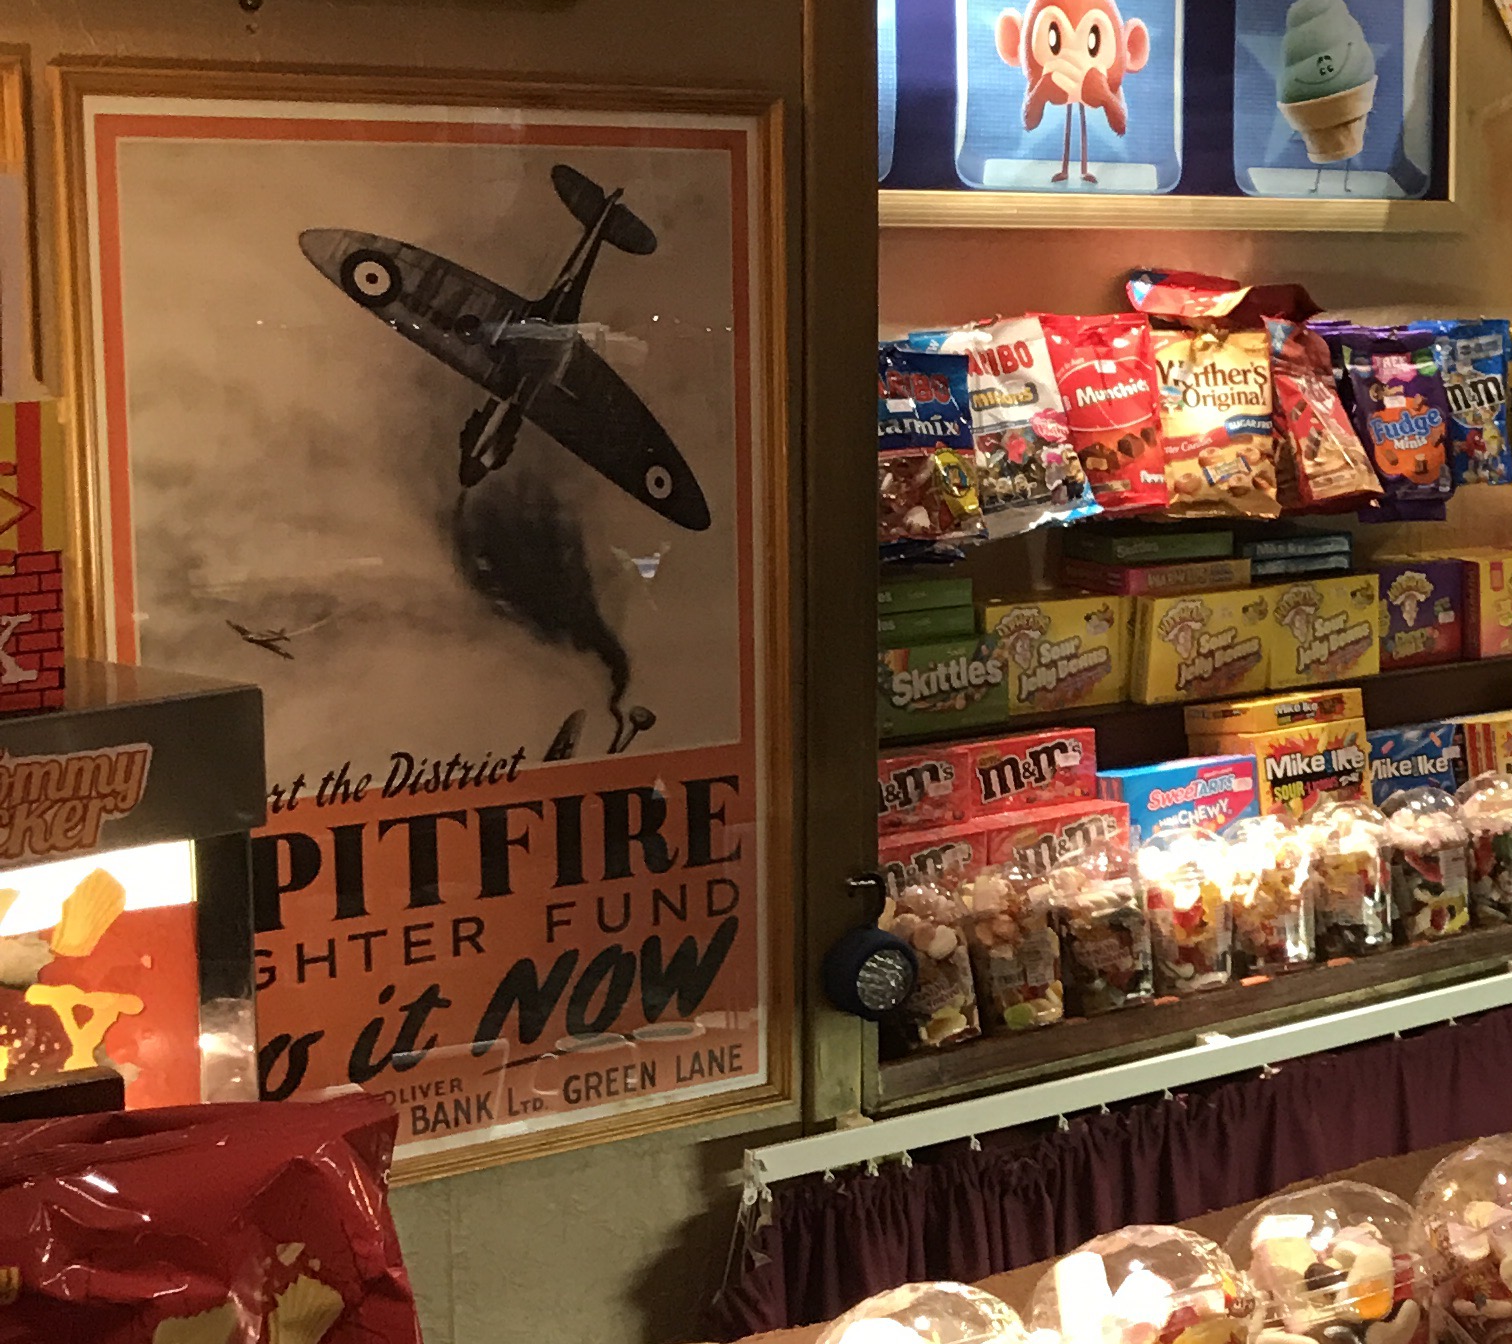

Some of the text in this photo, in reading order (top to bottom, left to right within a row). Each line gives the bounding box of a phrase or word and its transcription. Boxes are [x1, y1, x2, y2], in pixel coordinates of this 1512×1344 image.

[1158, 360, 1268, 388] Wrther's
[1370, 410, 1441, 440] Fudge
[891, 656, 1002, 707] Skittles
[316, 761, 373, 808] the
[382, 745, 527, 799] District
[251, 774, 743, 935] PITFIRE
[254, 878, 741, 992] GHTER FUND
[348, 982, 453, 1085] it
[471, 914, 740, 1058] NOW
[411, 1092, 494, 1137] BANK
[562, 1060, 657, 1106] GREEN
[676, 1043, 744, 1085] LANE
